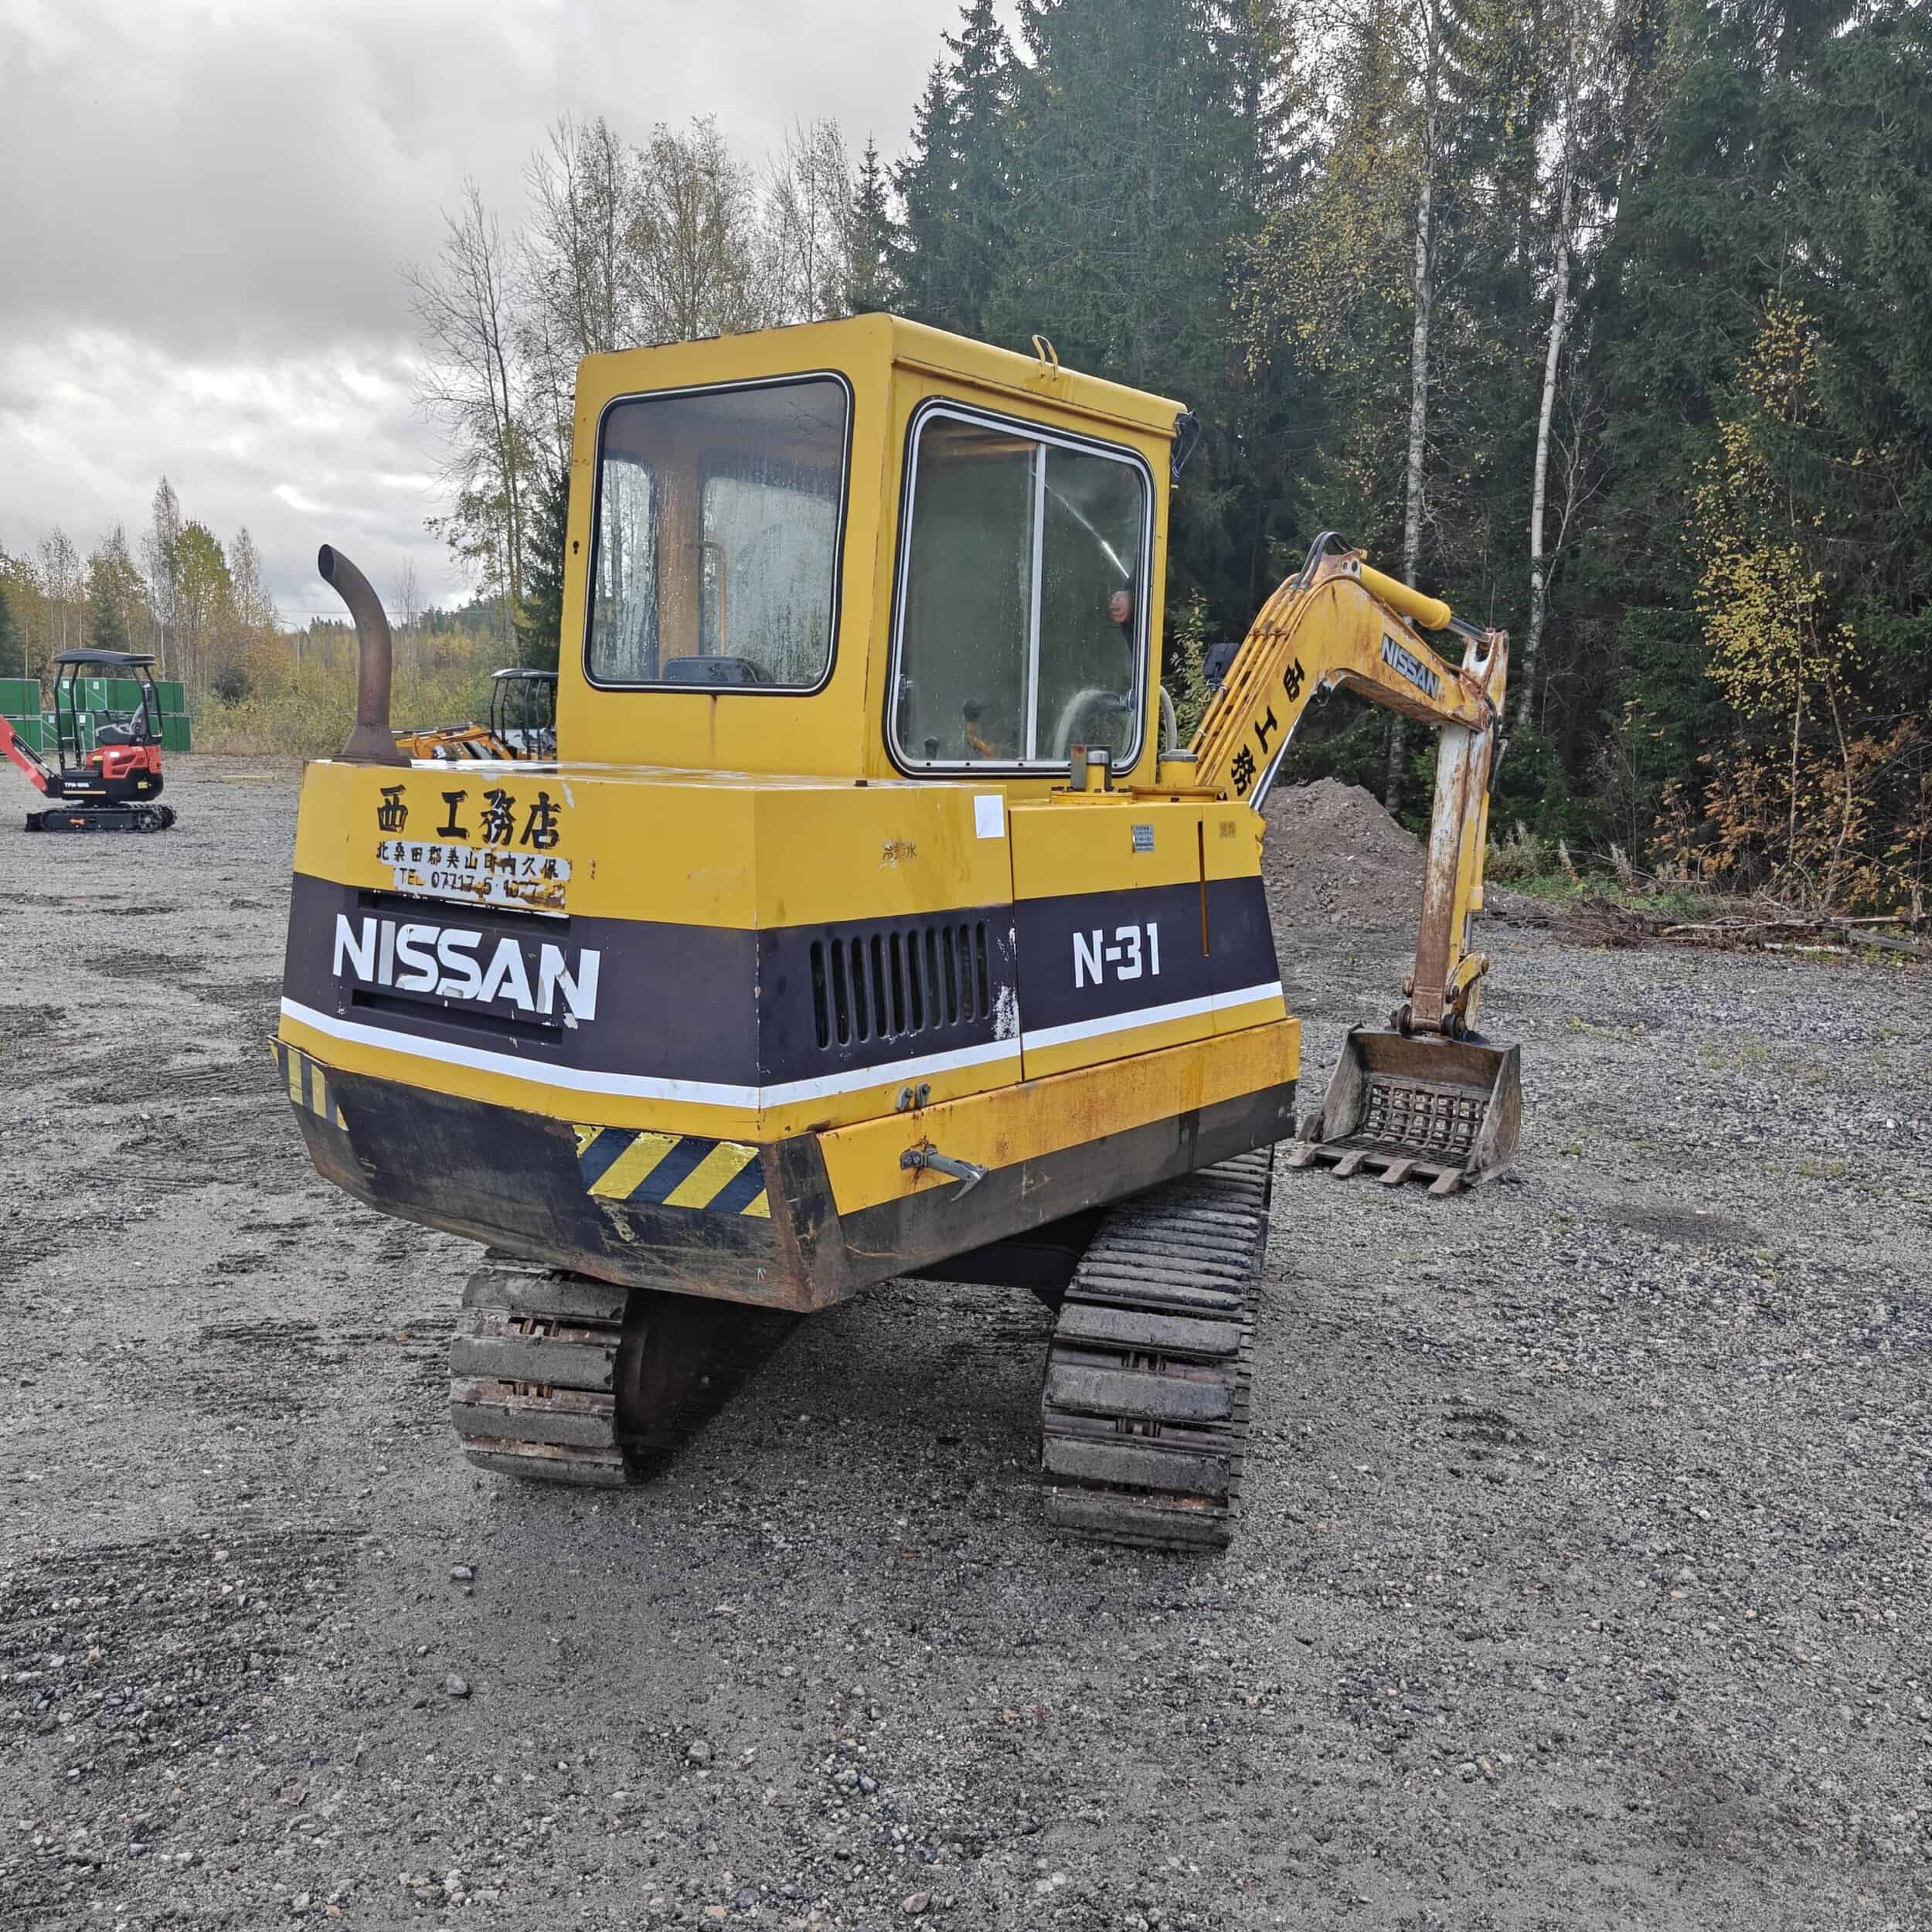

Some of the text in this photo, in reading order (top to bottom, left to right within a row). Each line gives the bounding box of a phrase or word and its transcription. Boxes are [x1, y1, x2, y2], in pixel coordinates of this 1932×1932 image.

[1380, 634, 1439, 699] NISSAN
[400, 867, 424, 886] TEL
[332, 913, 600, 1020] NISSAN
[1073, 923, 1161, 988] N-31
